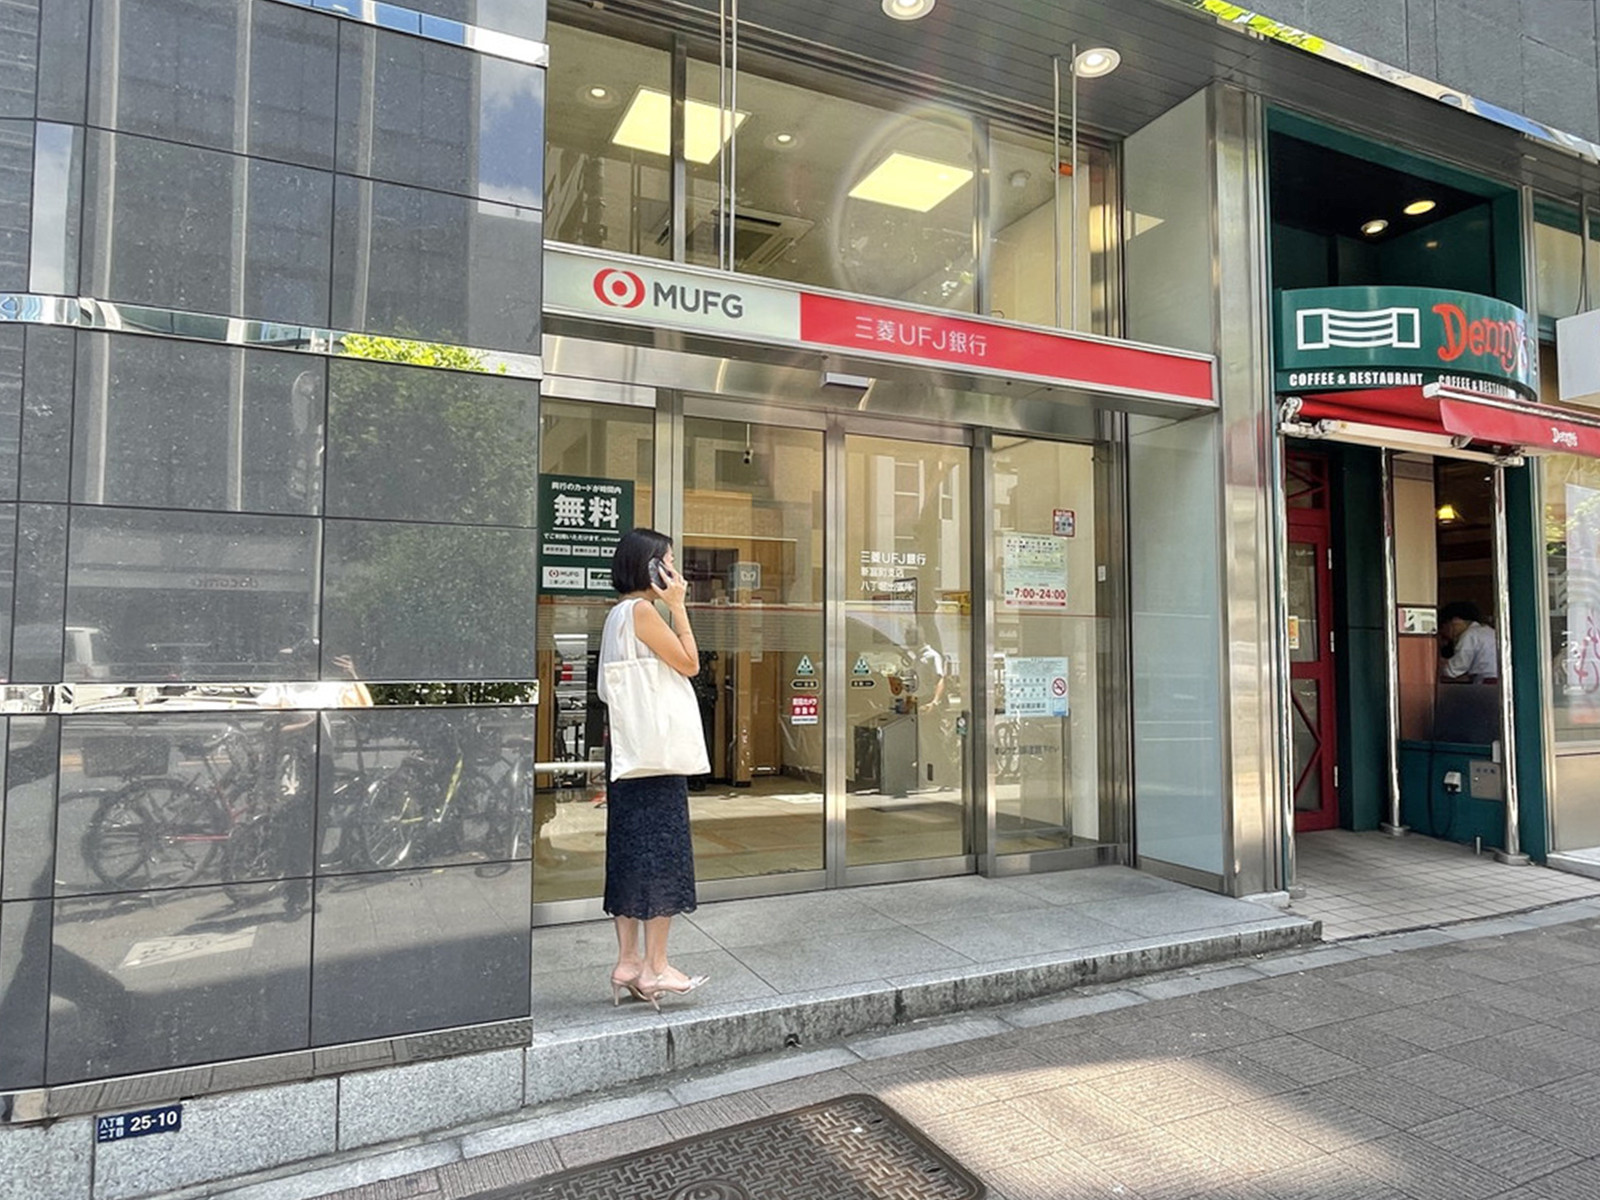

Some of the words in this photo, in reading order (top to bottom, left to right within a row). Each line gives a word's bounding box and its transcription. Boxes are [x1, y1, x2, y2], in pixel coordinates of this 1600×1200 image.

[653, 282, 743, 319] MUFG
[855, 316, 987, 356] 三菱UFJ銀行
[1289, 372, 1335, 386] COFFEE
[1337, 374, 1346, 384] &
[1349, 372, 1423, 386] RESTAURANT
[554, 493, 619, 528] 無料
[100, 1127, 124, 1139] 二丁目
[130, 1111, 177, 1132] 25-10
